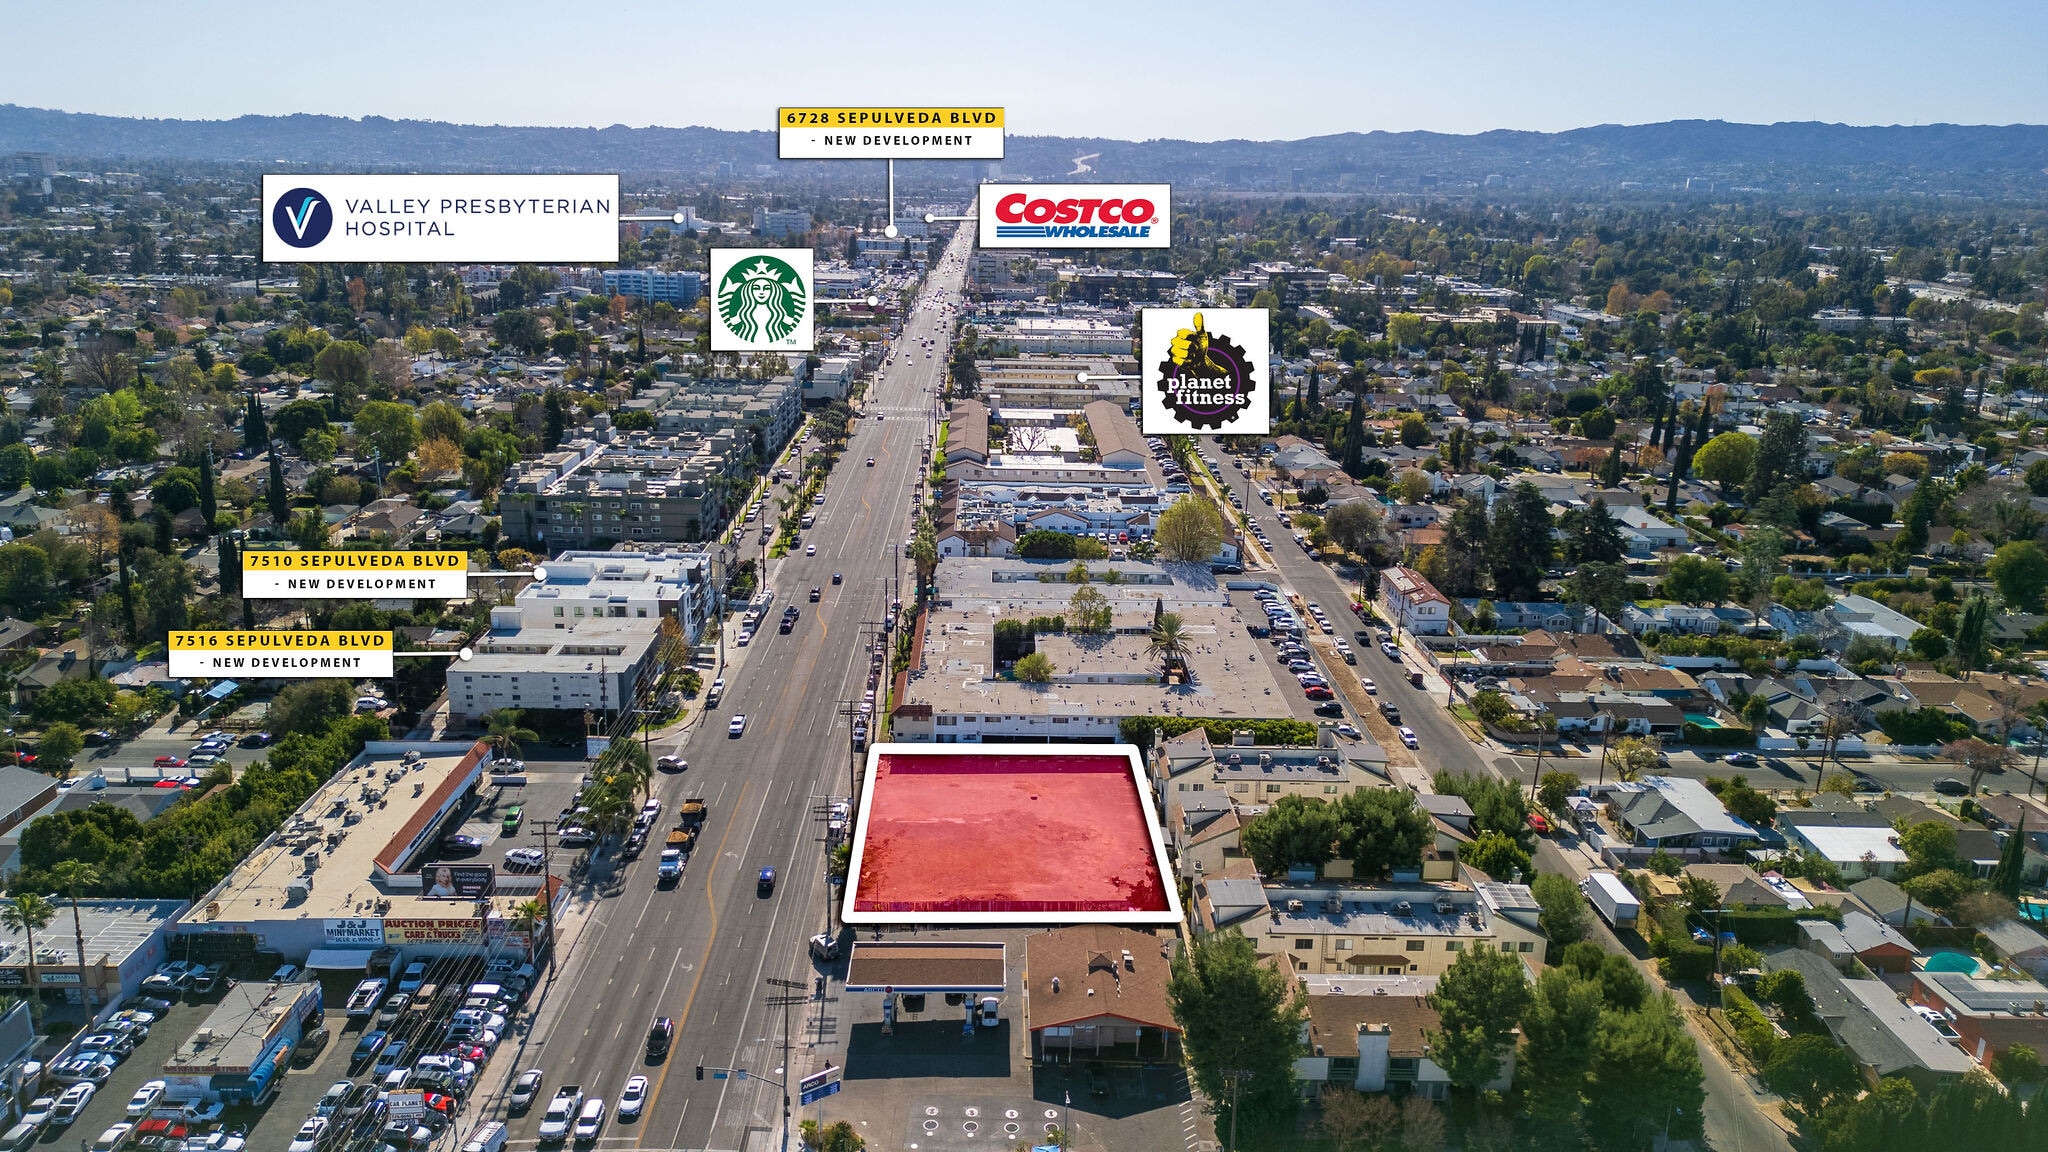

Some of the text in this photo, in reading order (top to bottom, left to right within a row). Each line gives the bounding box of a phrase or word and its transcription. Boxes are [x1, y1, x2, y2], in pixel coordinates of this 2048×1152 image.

[385, 920, 480, 928] AUCTION PRICES
[404, 931, 425, 939] CARS
[434, 931, 461, 939] TRUCKS
[803, 1080, 819, 1090] ARCO
